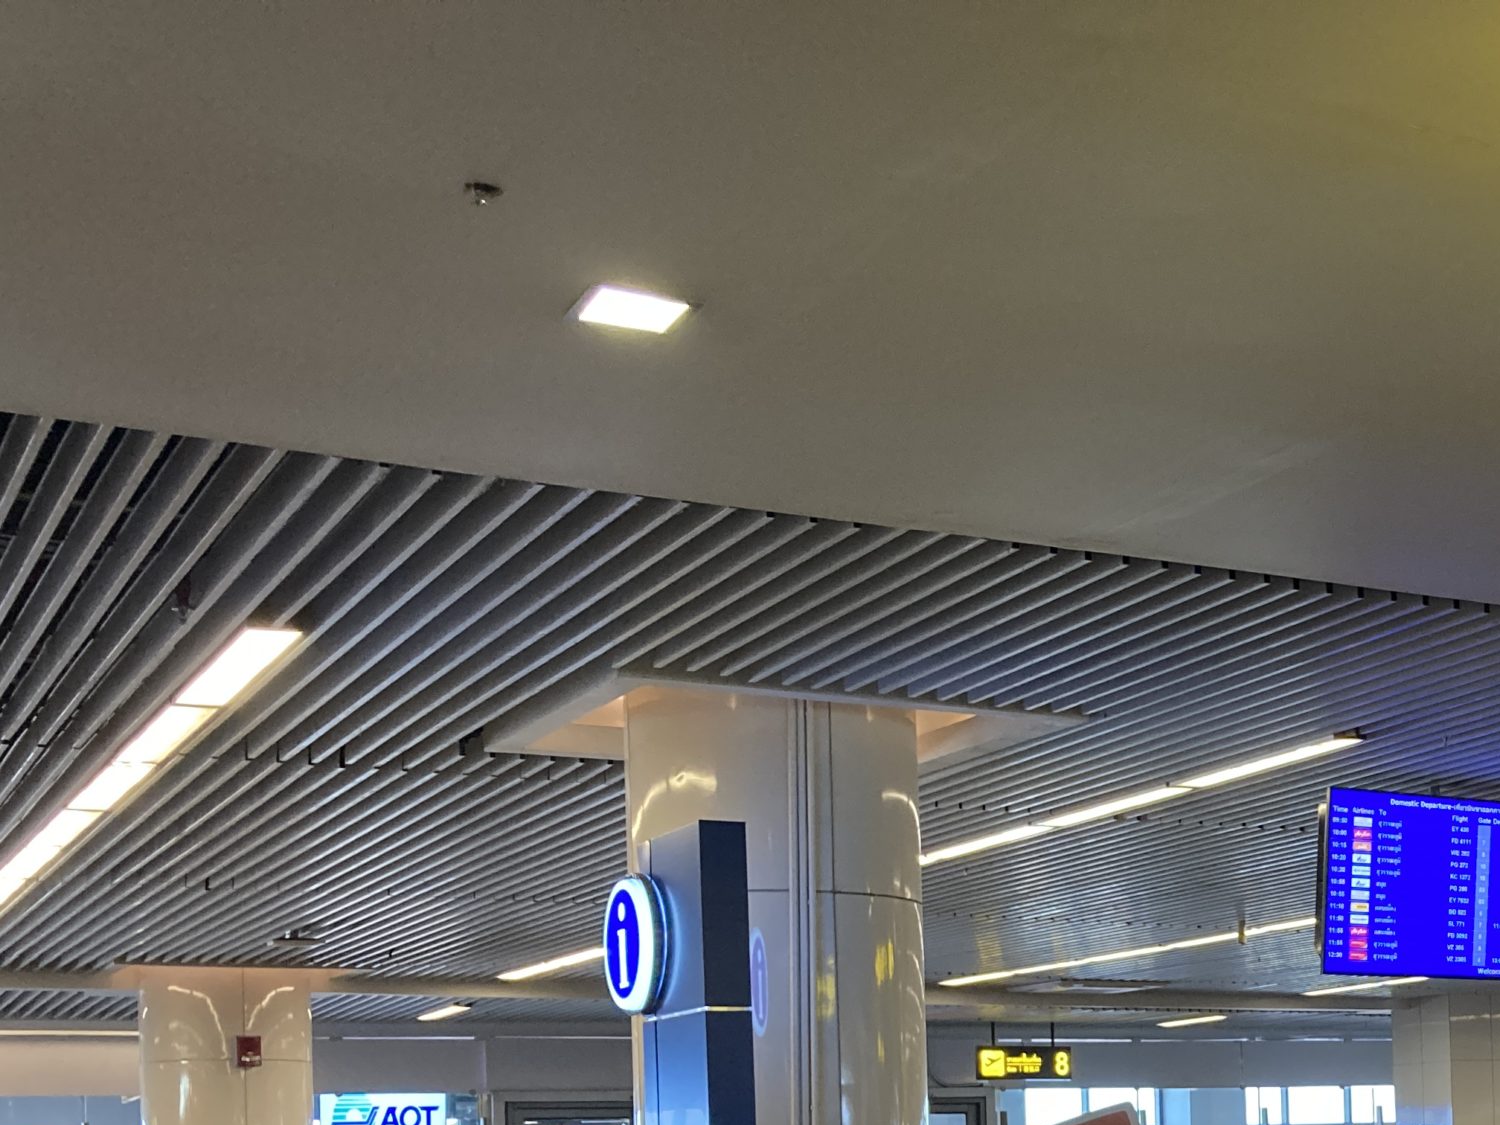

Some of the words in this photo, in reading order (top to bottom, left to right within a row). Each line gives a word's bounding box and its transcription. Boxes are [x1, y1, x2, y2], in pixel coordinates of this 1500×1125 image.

[1390, 798, 1419, 808] Domestic
[1333, 805, 1348, 813] Time
[1452, 815, 1468, 823] Flight
[1478, 816, 1491, 824] Gate
[1055, 1051, 1069, 1076] 8
